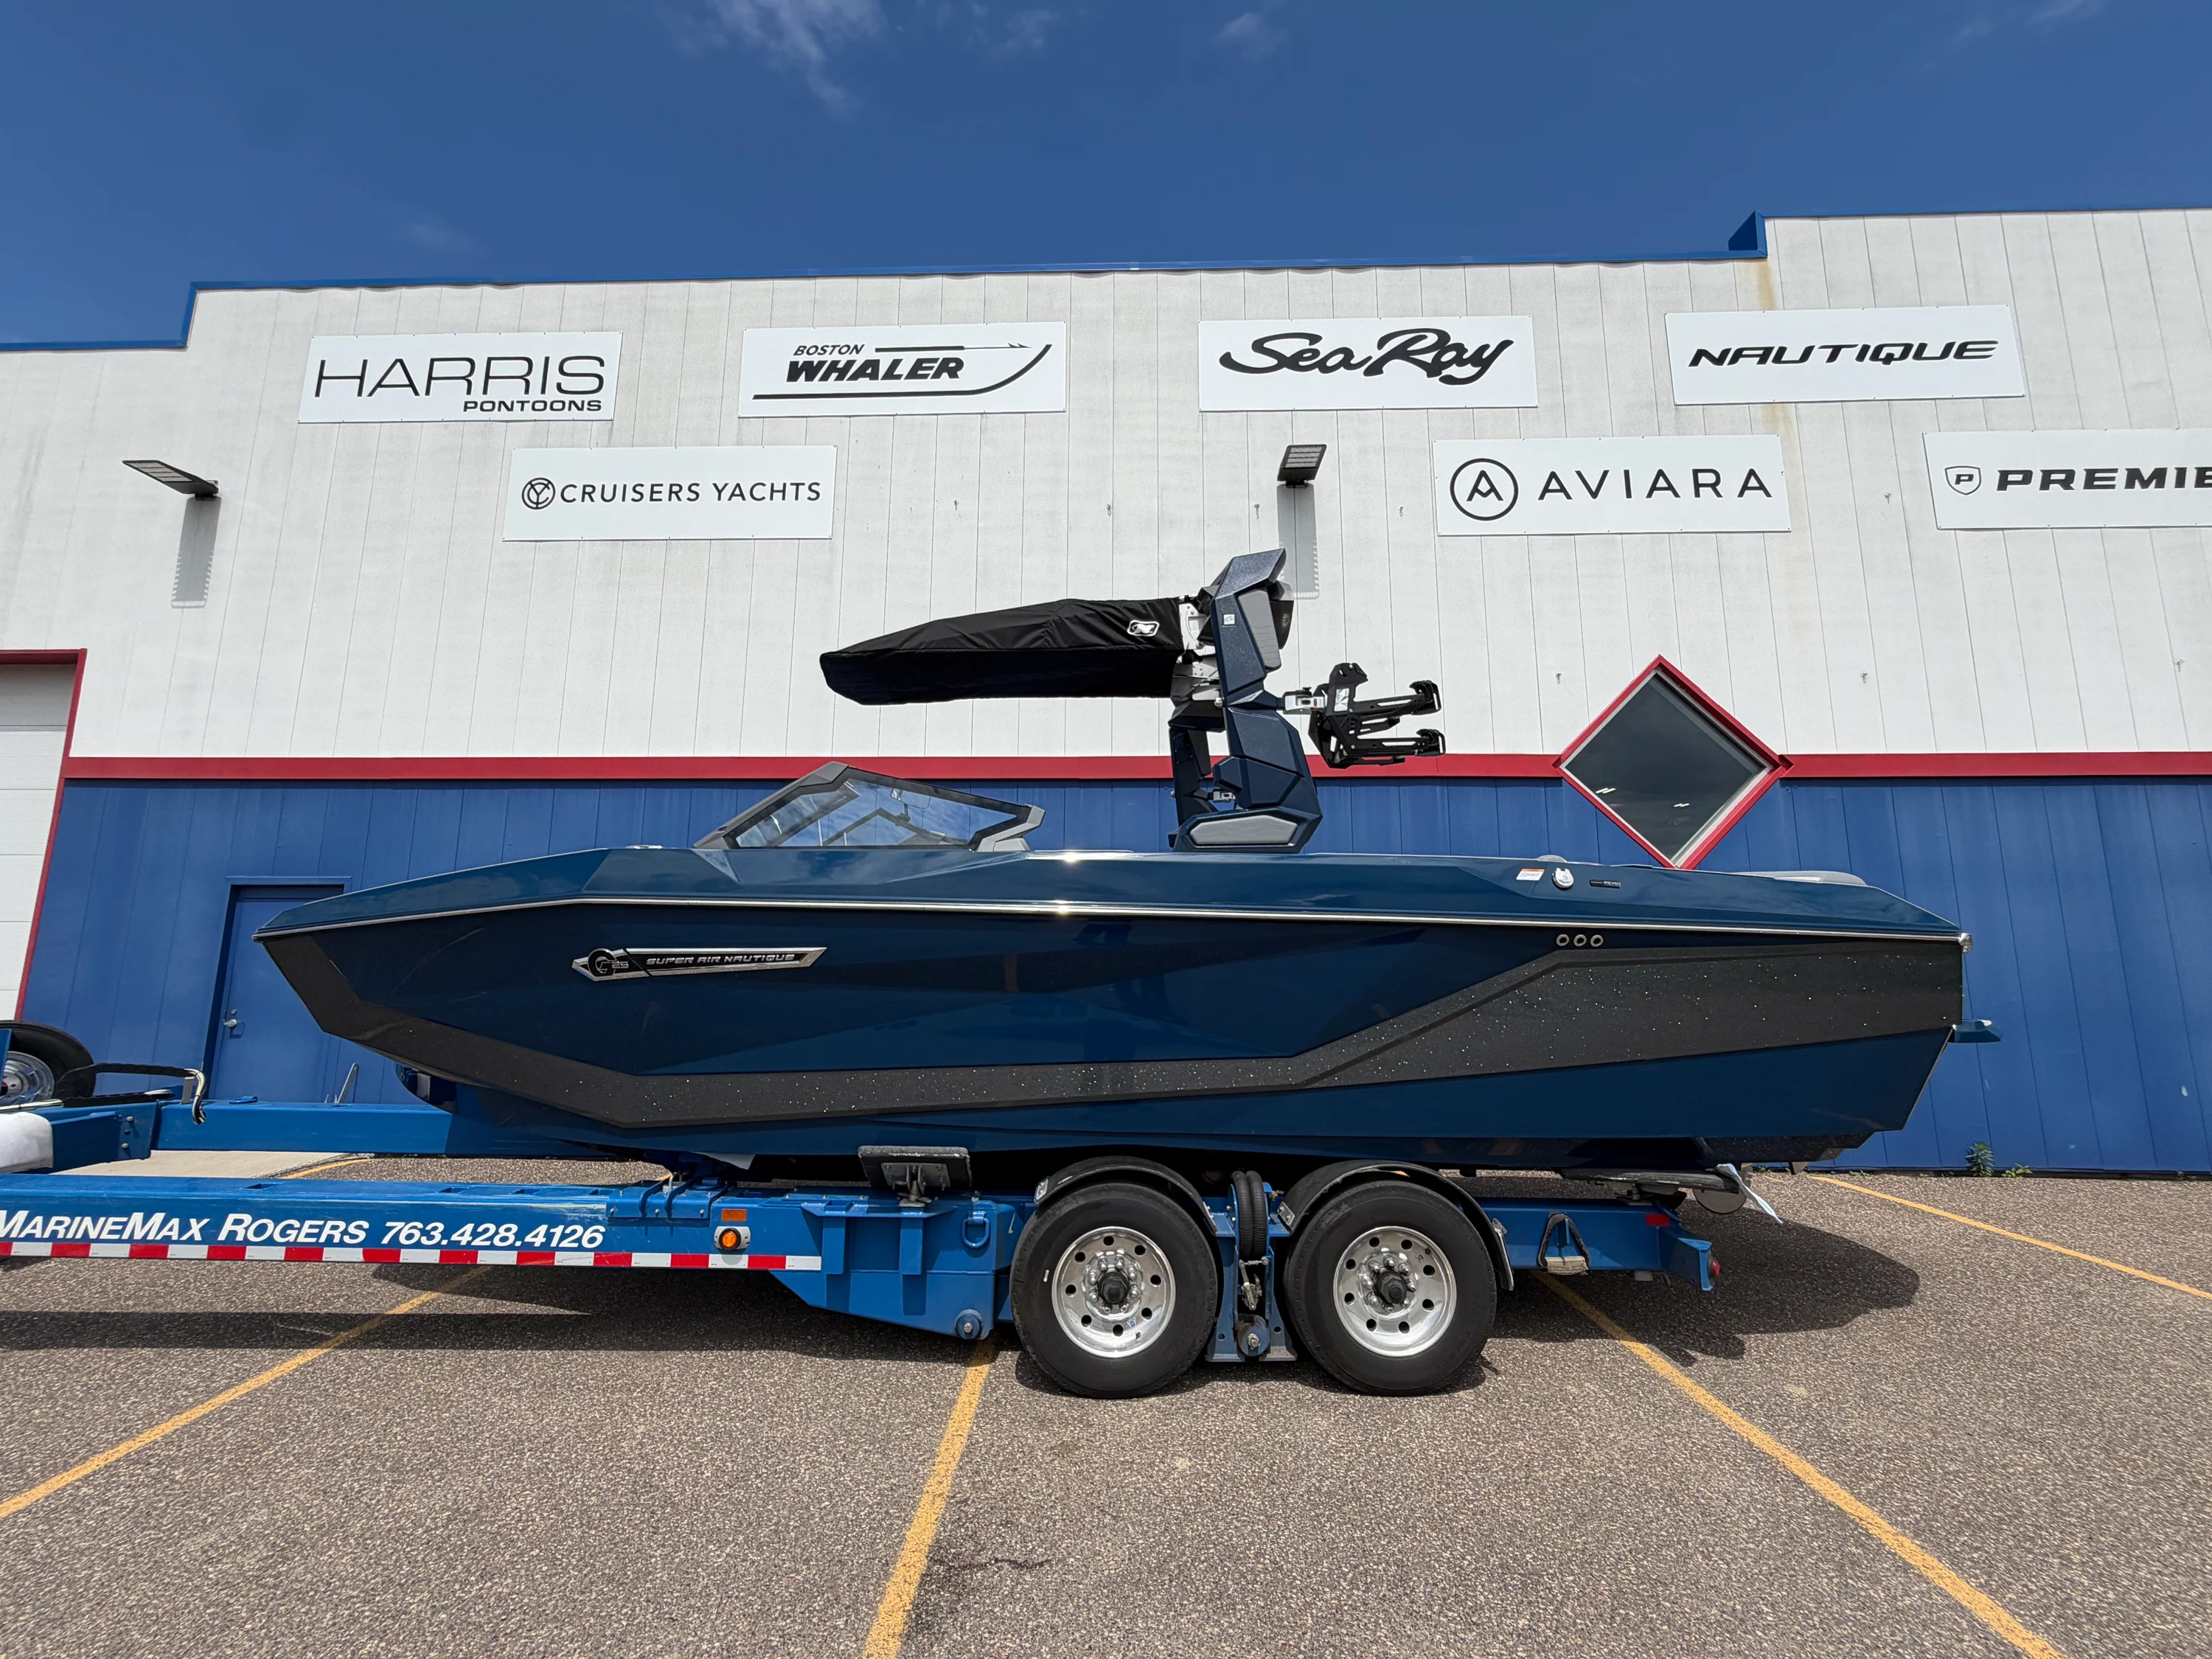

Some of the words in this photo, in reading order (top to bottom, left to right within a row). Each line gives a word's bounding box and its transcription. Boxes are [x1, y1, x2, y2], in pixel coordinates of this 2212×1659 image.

[793, 344, 865, 356] BOSTON
[1219, 332, 1374, 374] Sea
[1363, 327, 1514, 385] Ray
[1688, 340, 1998, 367] NAUTIQUE
[314, 355, 605, 397] HARRIS
[786, 357, 964, 383] WHALER
[463, 400, 602, 412] PONTOONS
[560, 482, 700, 504] CRUISERS
[712, 481, 821, 501] YACHTS
[1537, 468, 1773, 501] AVIARA
[646, 957, 694, 965] SUPER
[723, 954, 795, 962] NAUTIQUE
[218, 1213, 369, 1244] ROGERS
[380, 1221, 606, 1248] 763.428.4126
